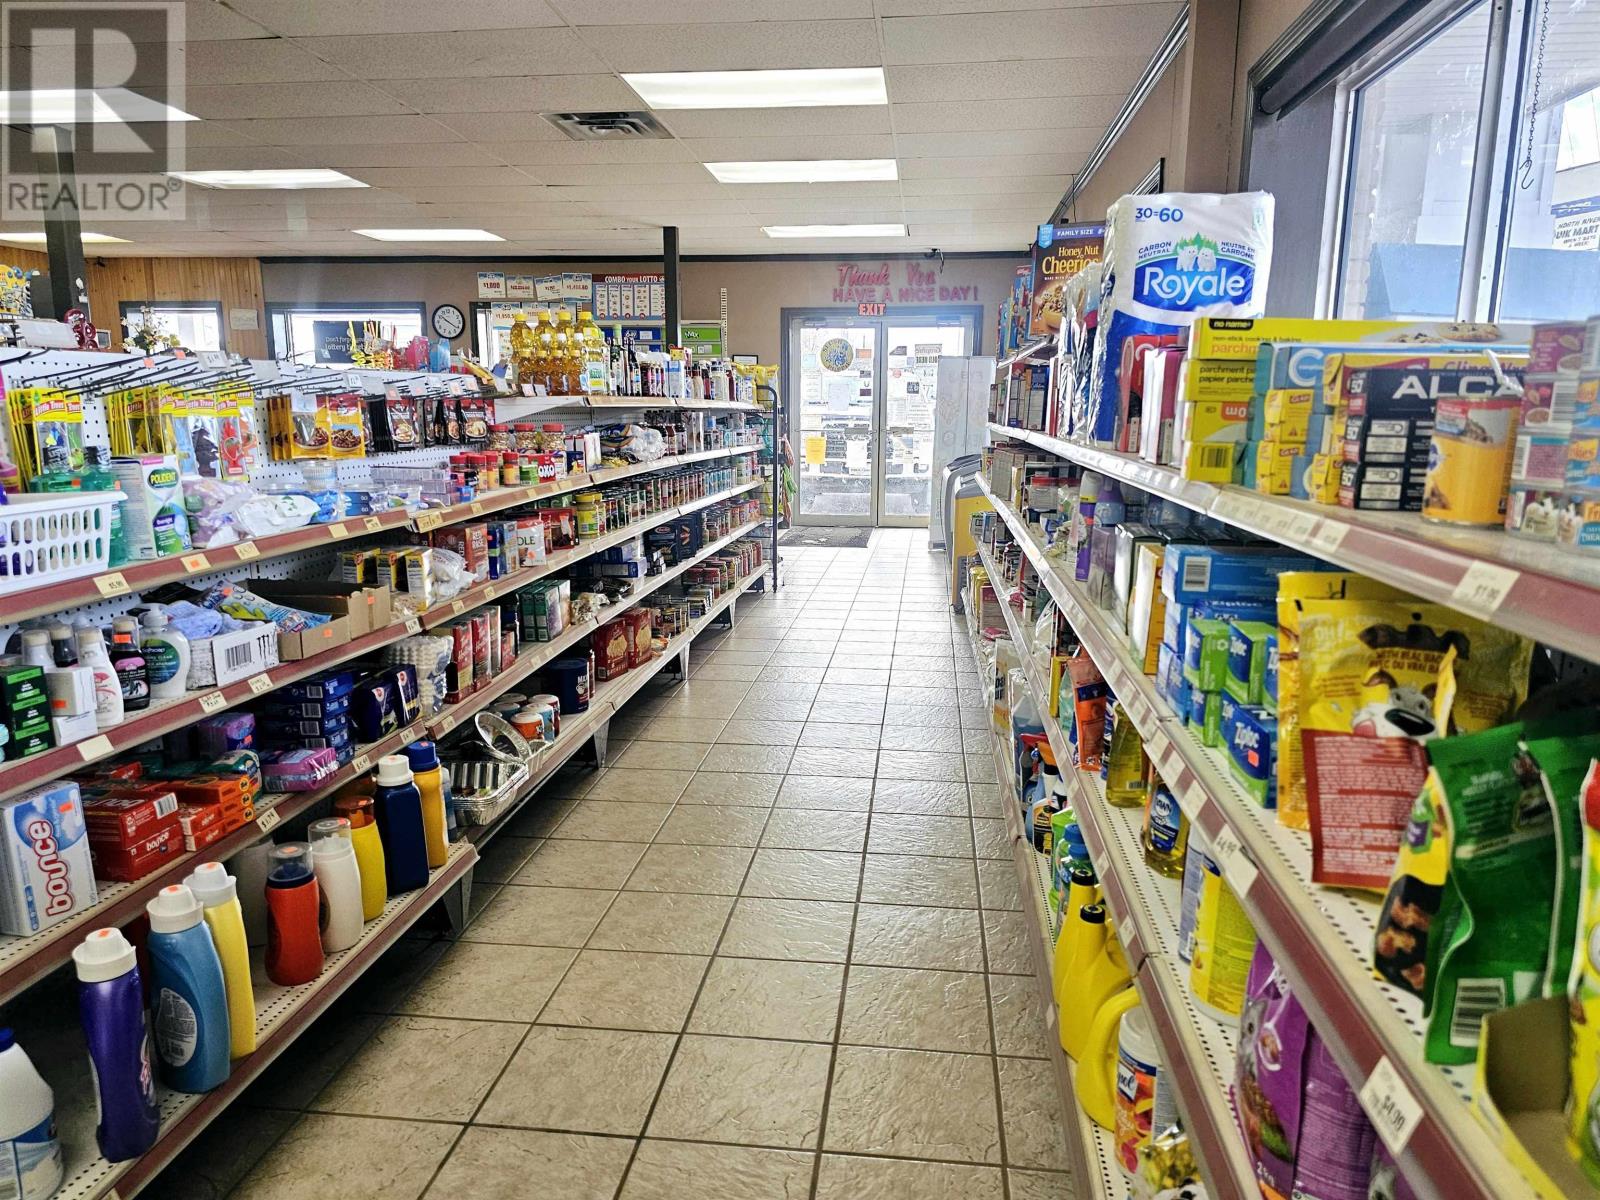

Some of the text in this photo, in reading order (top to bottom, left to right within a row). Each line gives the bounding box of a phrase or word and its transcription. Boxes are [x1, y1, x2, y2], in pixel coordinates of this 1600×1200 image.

[1058, 245, 1099, 258] Honey Nut
[1138, 241, 1172, 254] CARBON
[1138, 248, 1171, 260] NEUTRAL
[604, 275, 626, 283] COMBO
[639, 275, 657, 283] LOTTO
[837, 262, 936, 287] Thank You
[1143, 267, 1245, 305] Royale
[832, 285, 978, 303] HAVE A NICE DAY!
[859, 303, 886, 316] EXIT
[1200, 366, 1245, 374] parchment
[538, 464, 555, 478] OXO
[146, 830, 170, 852] bounce
[28, 820, 74, 918] bounce
